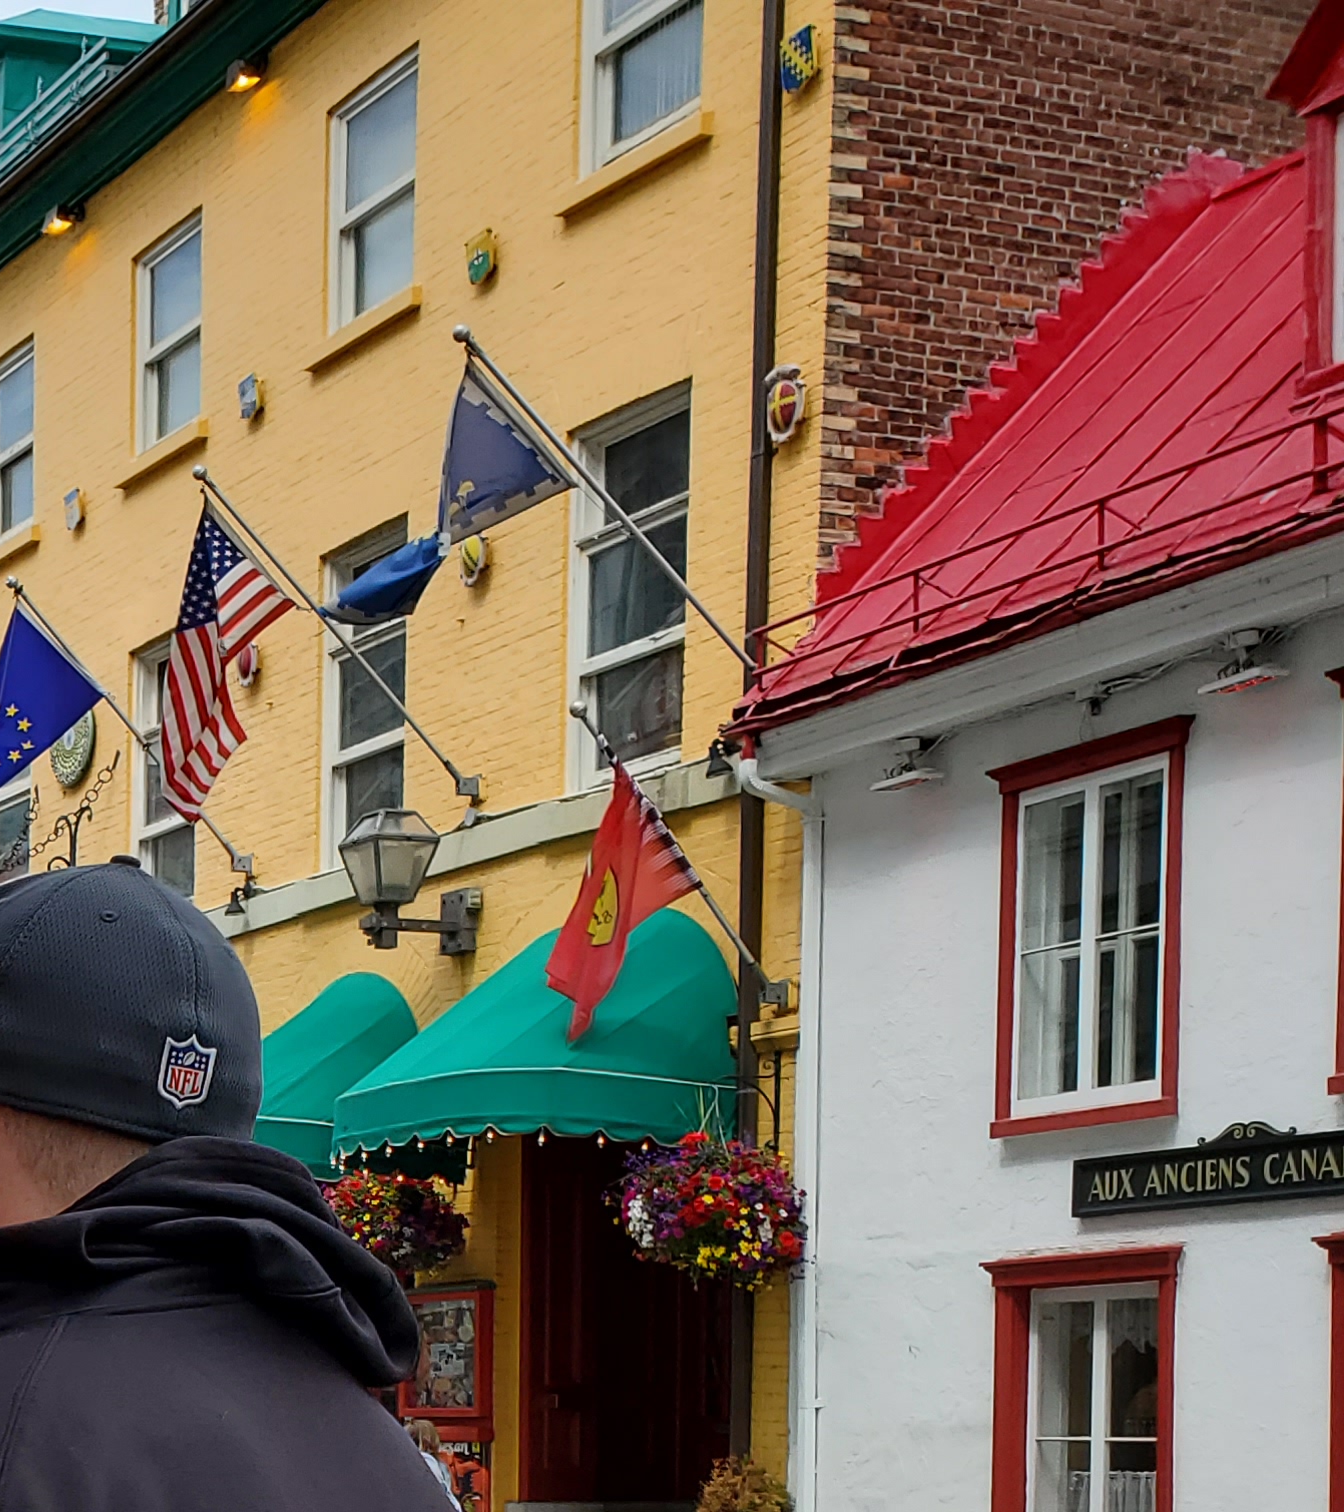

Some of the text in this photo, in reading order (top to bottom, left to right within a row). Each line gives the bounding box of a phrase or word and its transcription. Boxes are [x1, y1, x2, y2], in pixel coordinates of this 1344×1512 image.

[168, 1066, 200, 1096] NFL
[1088, 1147, 1344, 1203] AUX ANCIENS CANA
